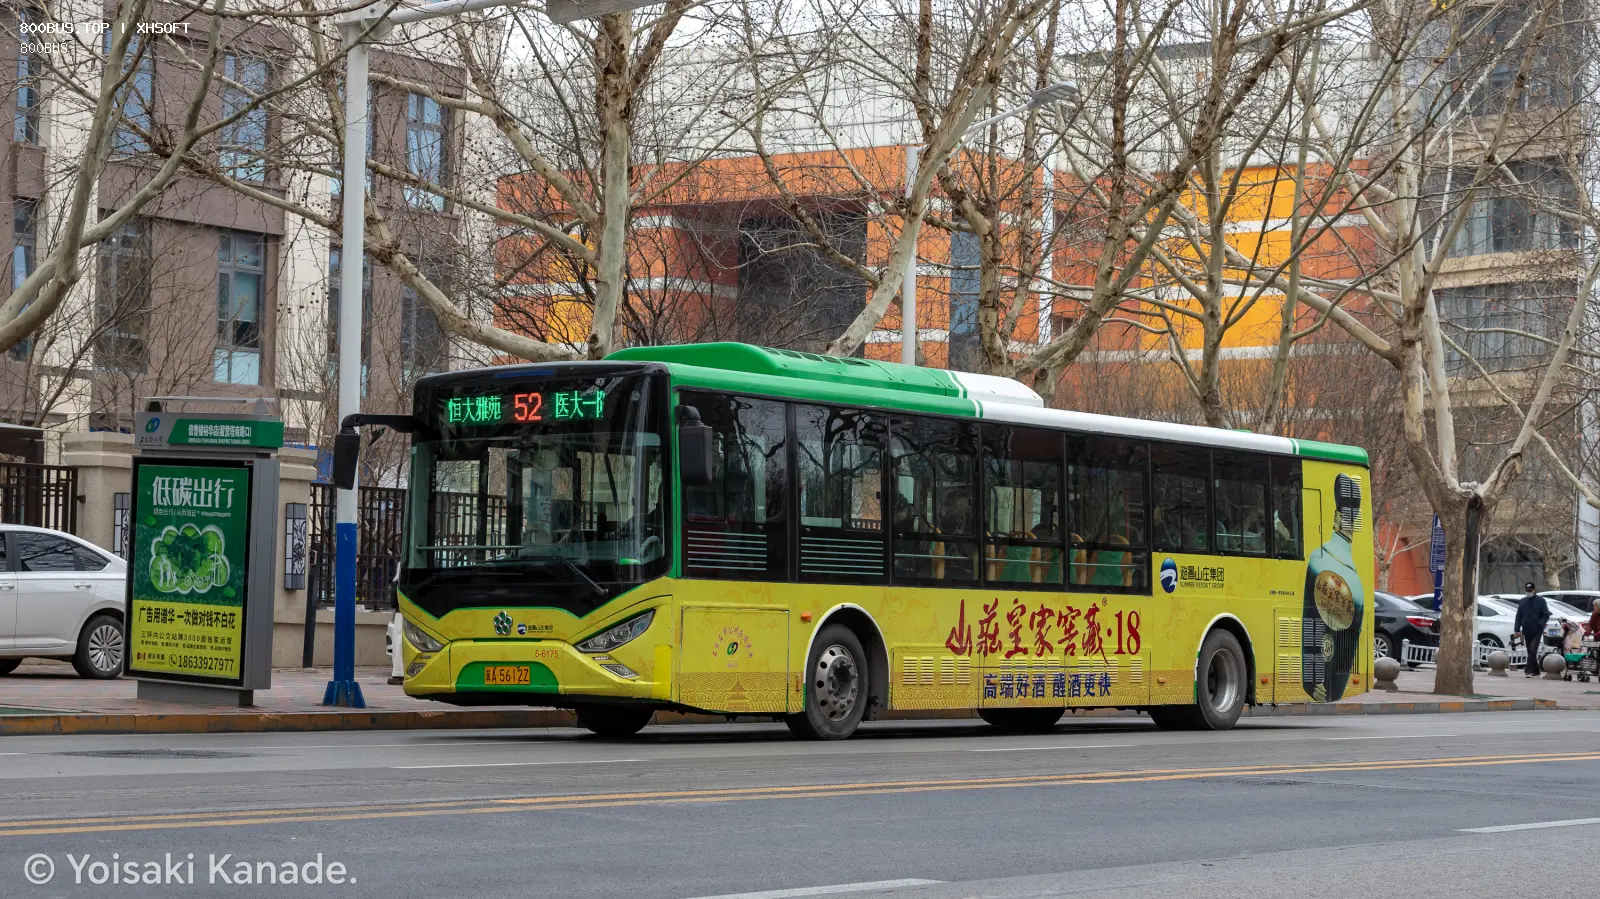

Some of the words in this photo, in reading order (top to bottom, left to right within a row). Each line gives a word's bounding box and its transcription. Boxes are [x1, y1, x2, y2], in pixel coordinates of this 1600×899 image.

[448, 396, 502, 423] 恒大雅苑
[514, 392, 542, 421] 52
[152, 475, 235, 509] 低碳出行
[1179, 565, 1225, 582] 避暑山庄集团
[138, 605, 175, 625] 广告用谱华
[176, 608, 237, 630] 一次做对钱不白花
[178, 655, 235, 672] 18633927977
[534, 649, 559, 659] 5-6175
[983, 673, 1046, 699] 高端好酒
[1052, 672, 1112, 699] 醒酒更快
